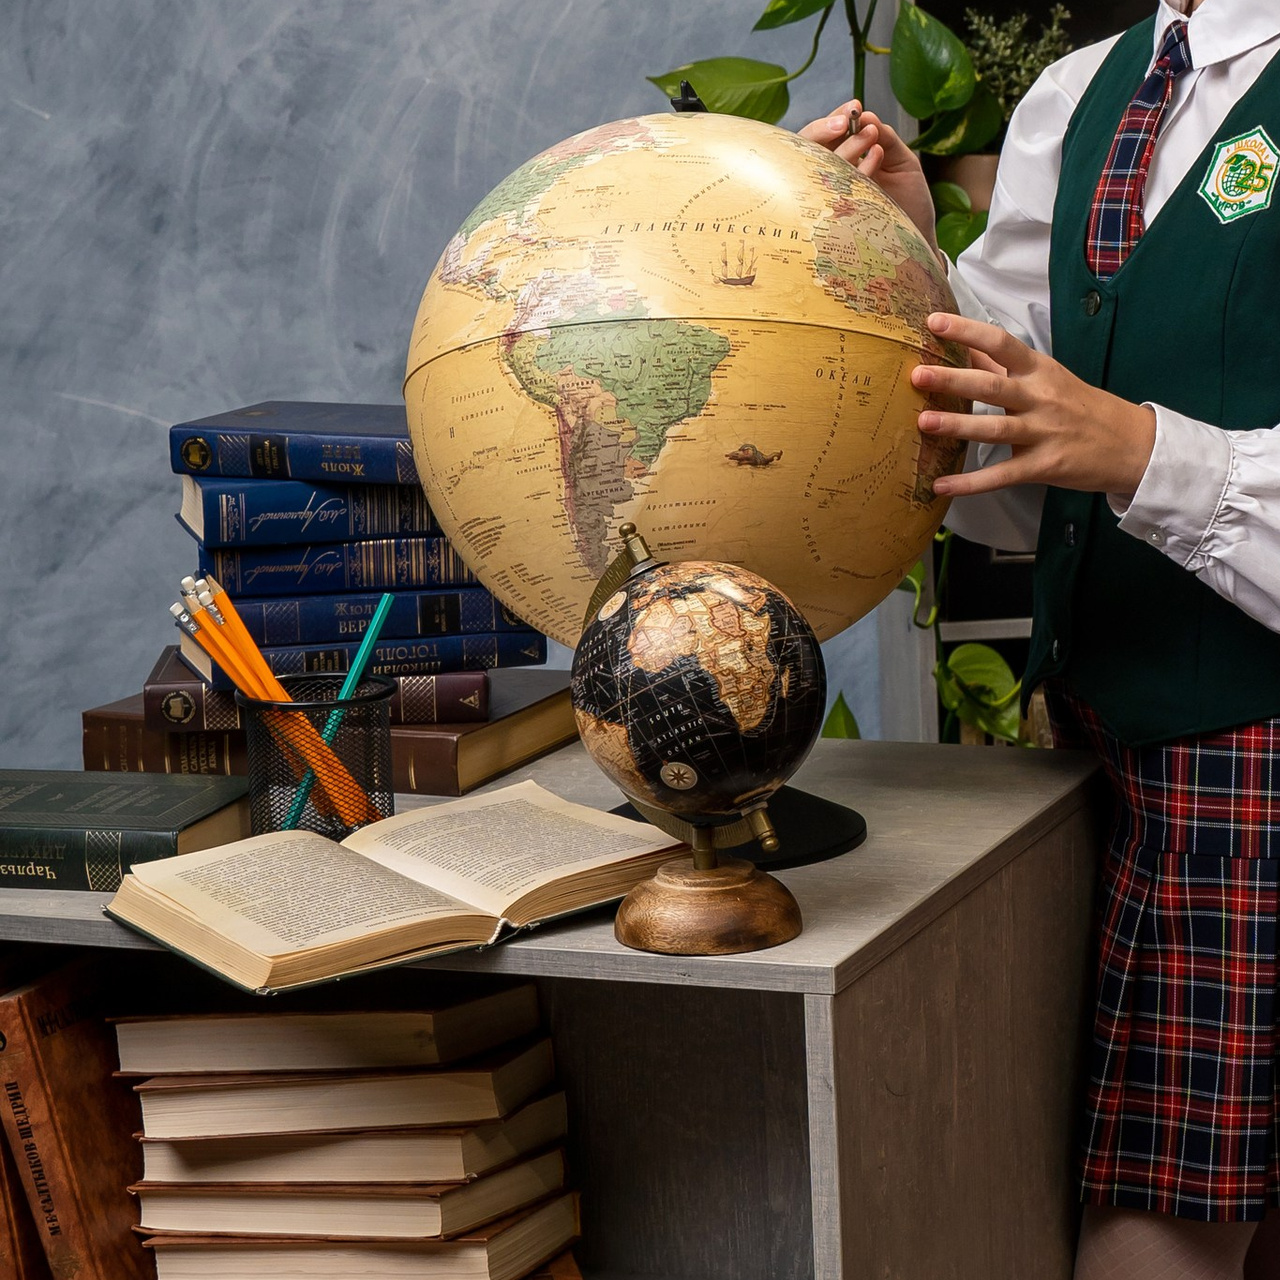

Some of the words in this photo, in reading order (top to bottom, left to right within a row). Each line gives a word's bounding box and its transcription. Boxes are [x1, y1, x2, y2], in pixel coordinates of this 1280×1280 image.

[1234, 139, 1267, 157] ШКОЛА
[1235, 160, 1275, 193] 25
[600, 221, 799, 241] АТЛАНТИЧЕСКИЙ
[816, 367, 872, 386] ОКЕАН
[320, 462, 366, 478] Жюль
[651, 521, 707, 533] котловина
[802, 516, 821, 563] хребет
[338, 621, 371, 635] ВЕР
[375, 644, 439, 662] ГОГОЛЬ
[649, 704, 684, 725] SOUTH
[654, 717, 704, 745] ATLANTIC
[666, 734, 702, 757] OCEAN
[0, 861, 57, 880] Чарльз
